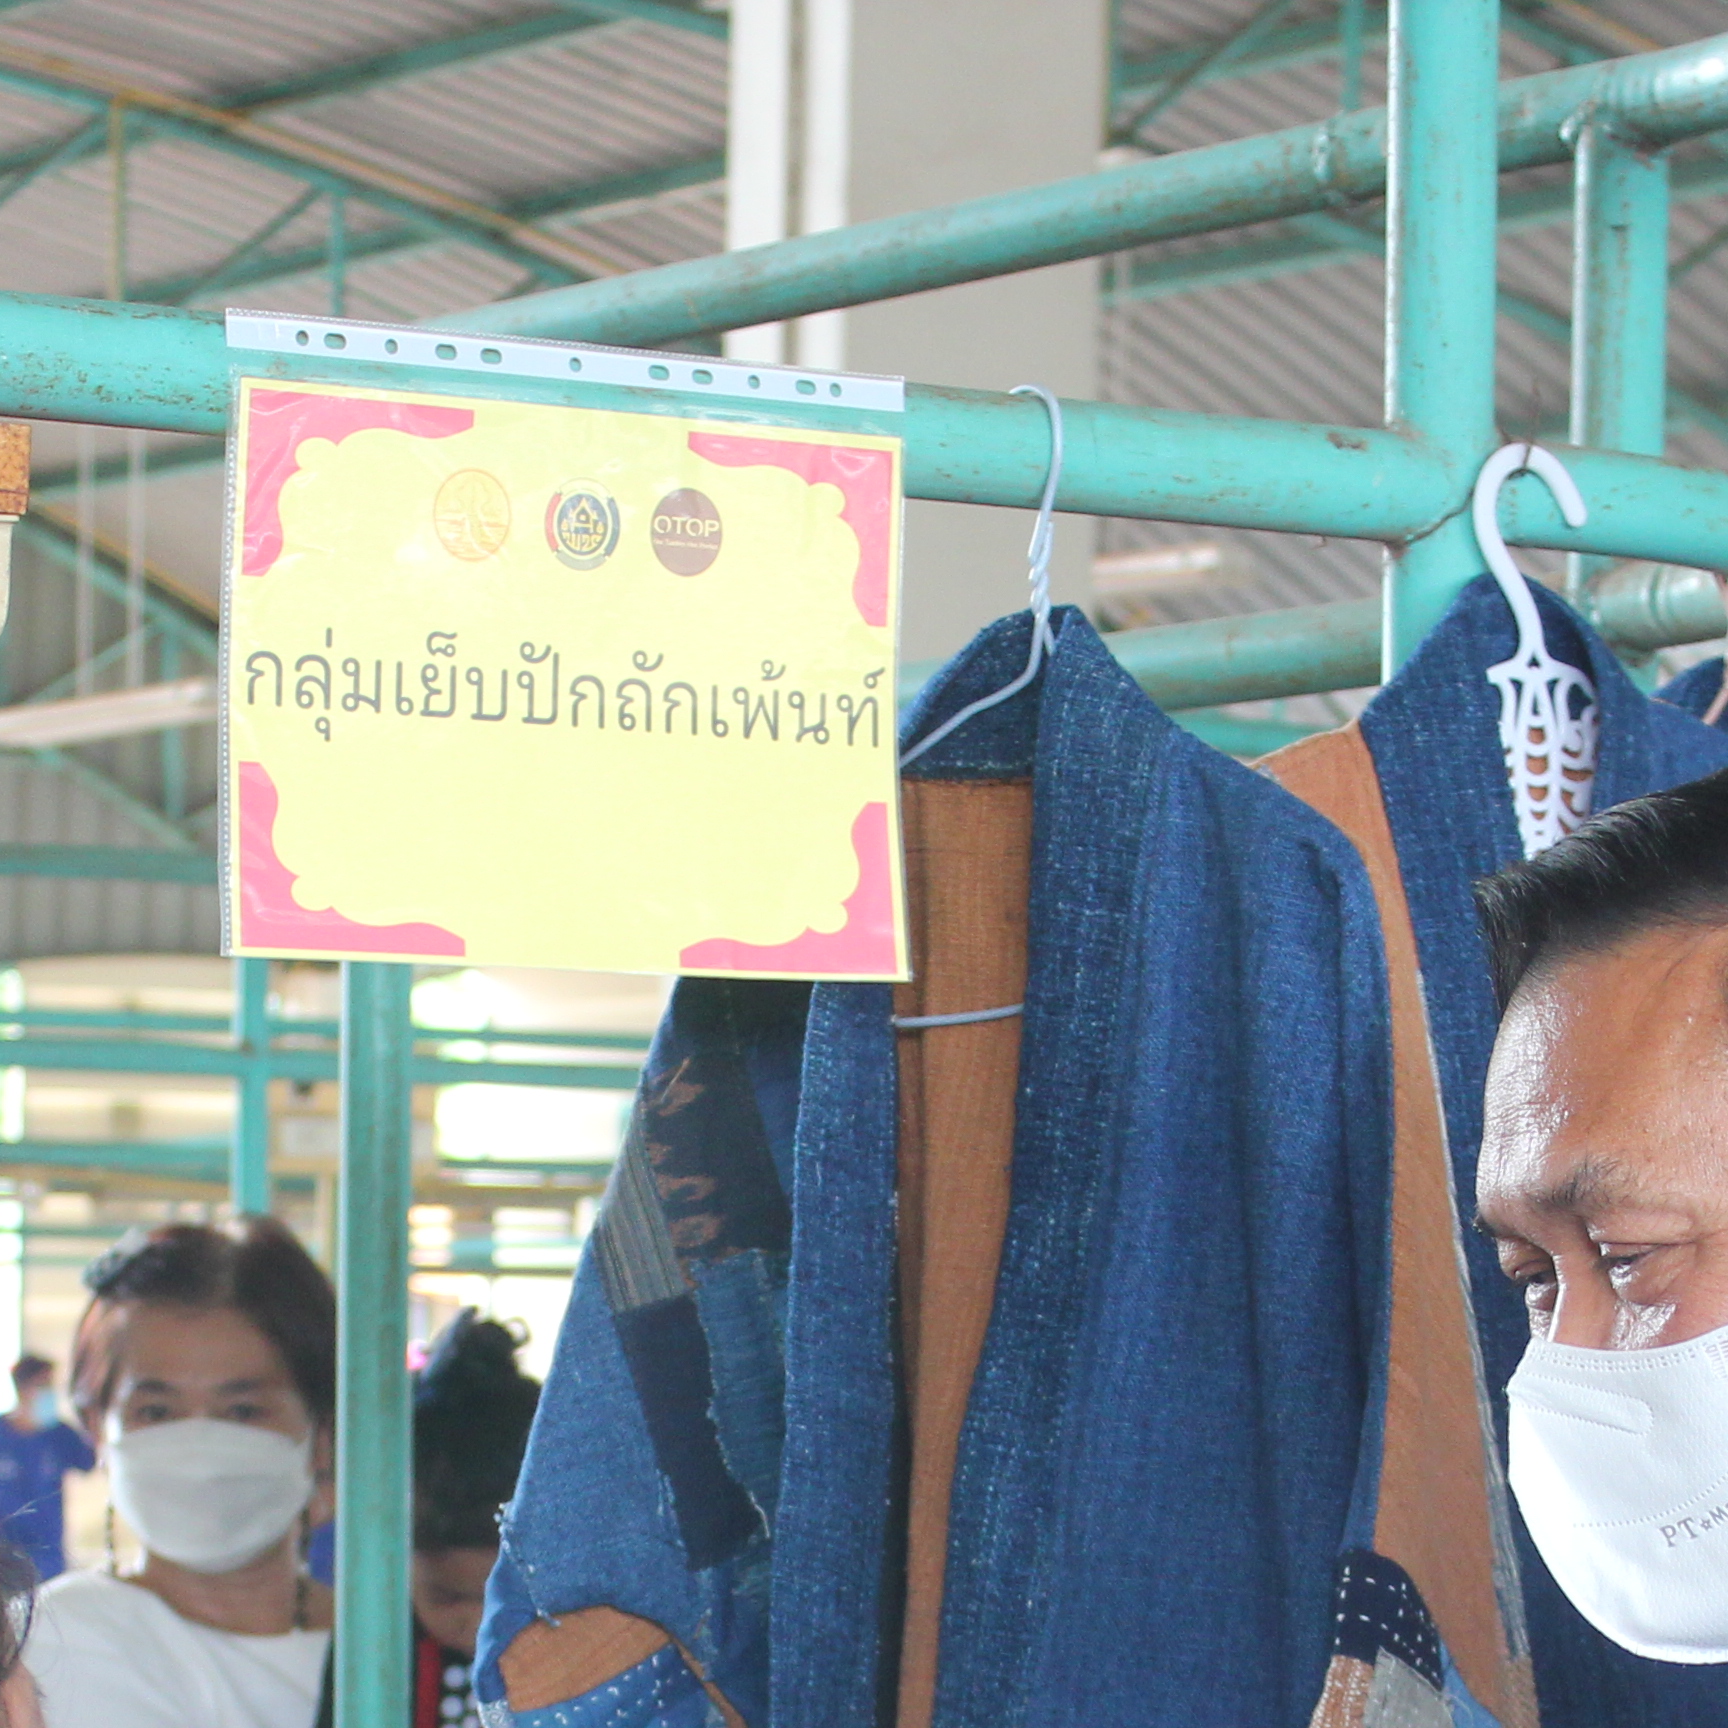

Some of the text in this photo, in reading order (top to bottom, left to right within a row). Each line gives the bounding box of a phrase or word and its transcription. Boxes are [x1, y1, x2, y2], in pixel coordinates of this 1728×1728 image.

[654, 515, 720, 537] OTOP
[244, 626, 887, 748] กลุ่มเย็บปักถักเพ้นท์
